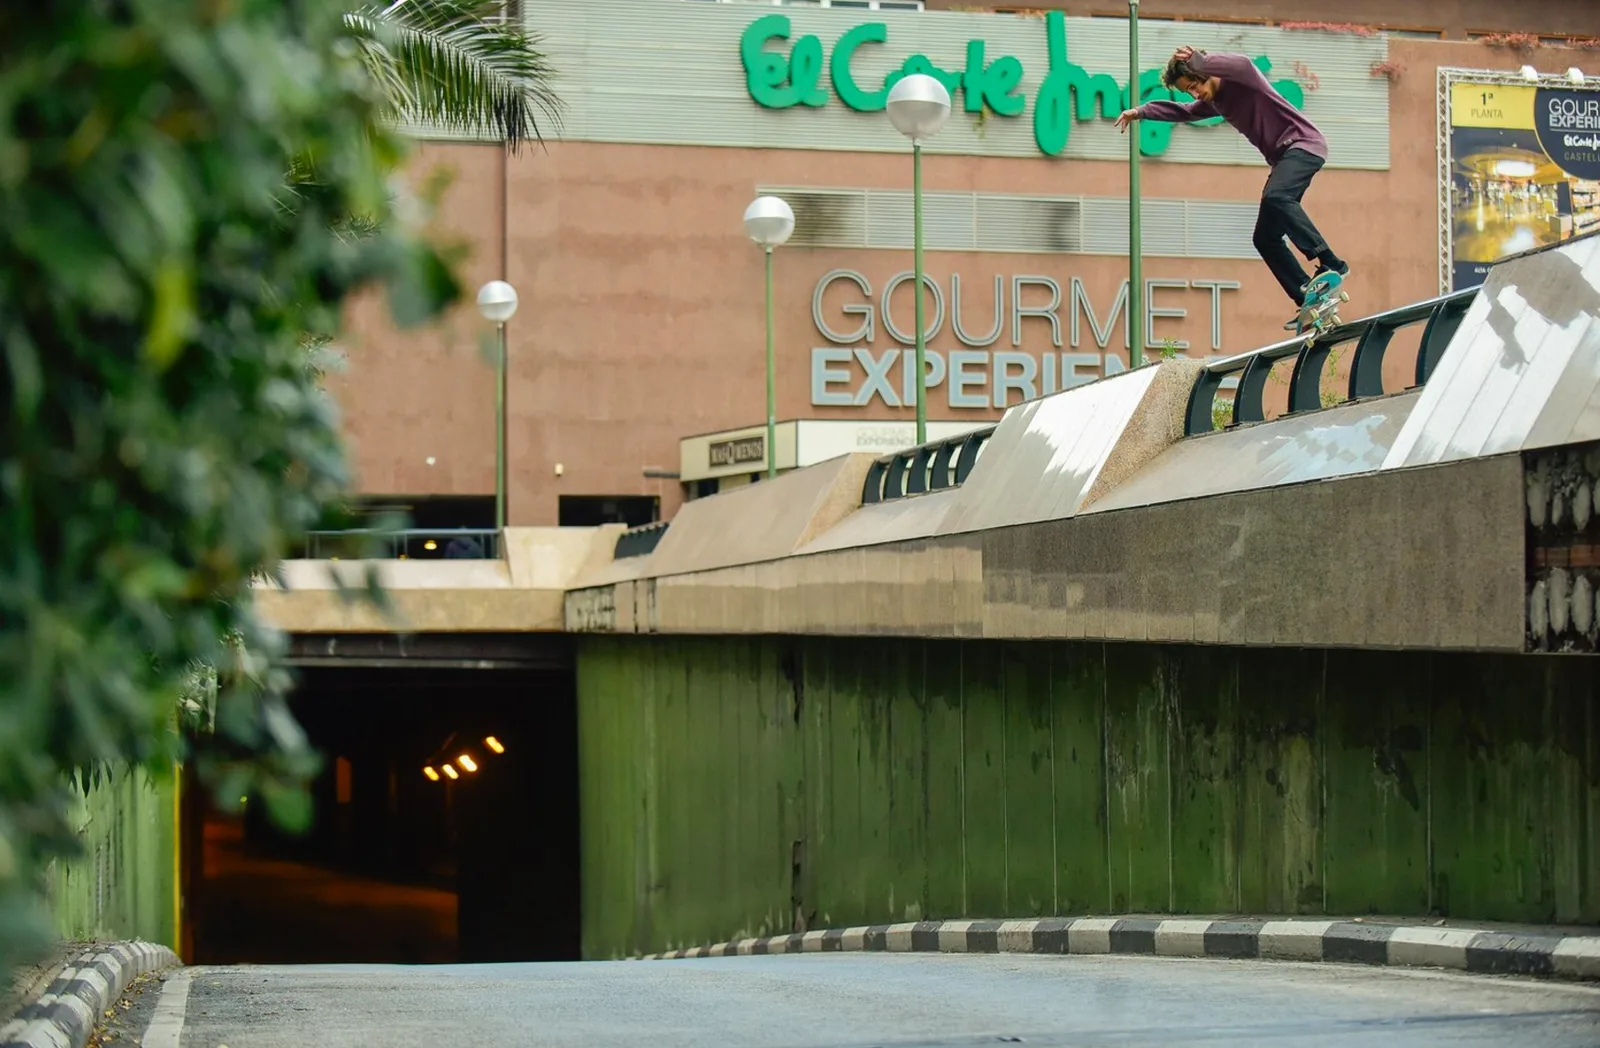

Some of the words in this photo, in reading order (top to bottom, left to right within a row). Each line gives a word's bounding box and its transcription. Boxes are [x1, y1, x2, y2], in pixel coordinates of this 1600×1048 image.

[741, 14, 829, 109] El
[1034, 10, 1304, 157] Ing
[1470, 108, 1504, 119] PLANTA
[1549, 113, 1600, 129] EXPERI
[812, 268, 1241, 350] GOURMET
[811, 347, 1240, 409] EXPERIE
